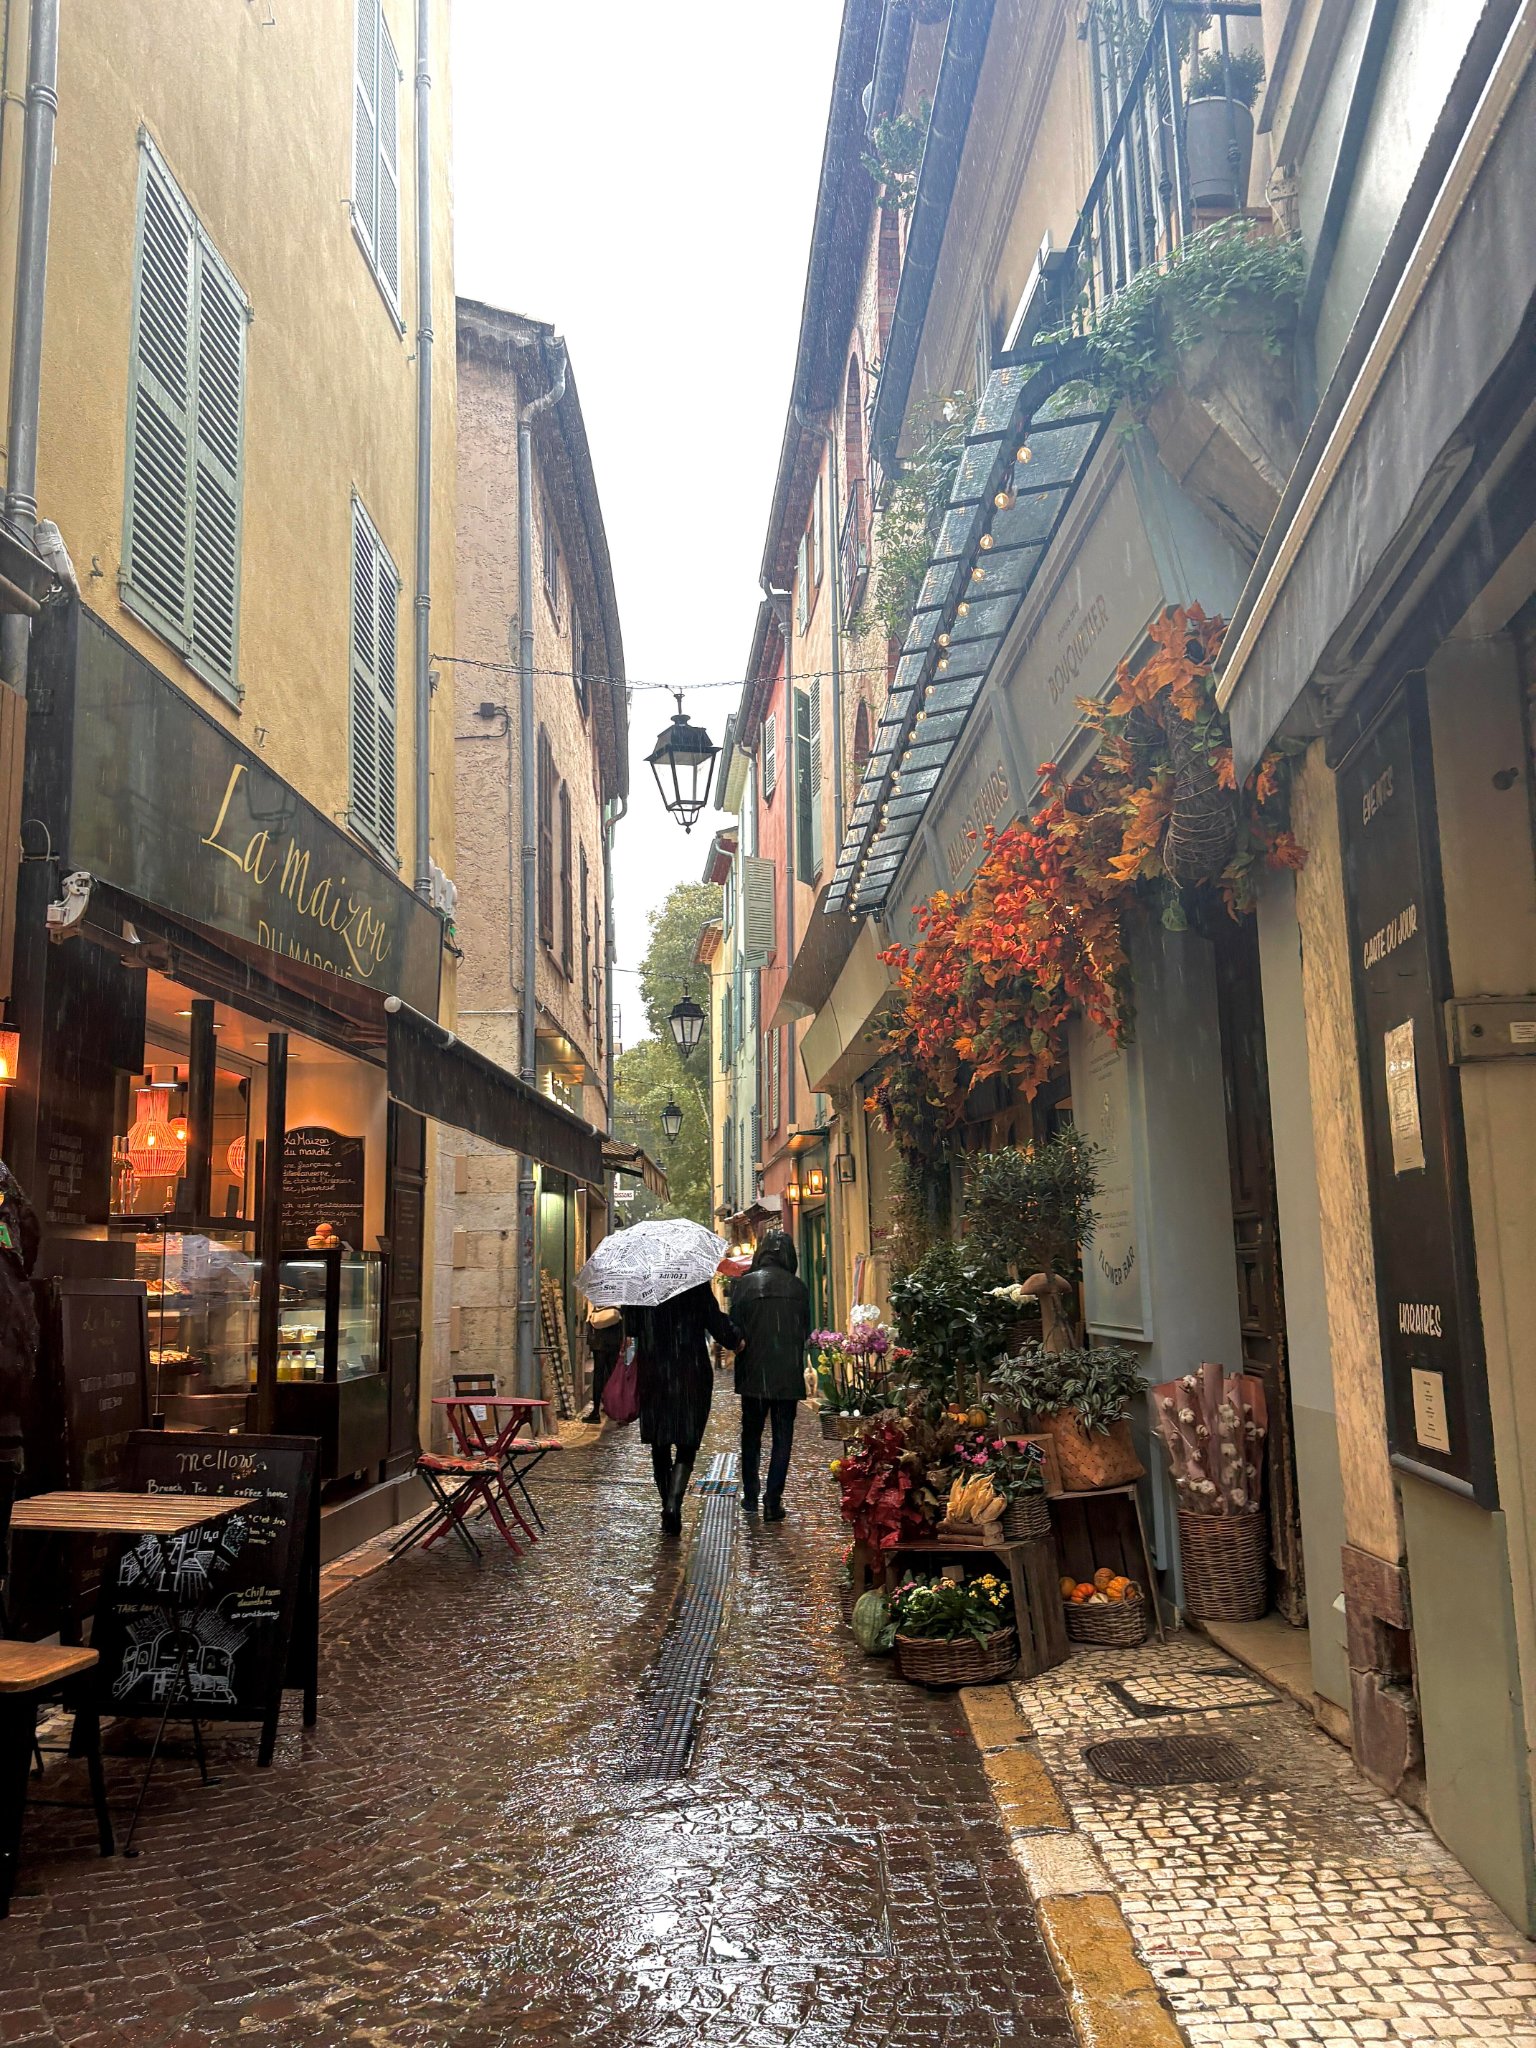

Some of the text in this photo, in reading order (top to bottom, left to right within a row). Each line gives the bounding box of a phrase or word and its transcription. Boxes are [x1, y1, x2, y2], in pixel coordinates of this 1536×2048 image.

[1048, 594, 1109, 705] BOUQUETIER
[201, 763, 392, 978] La Maizon
[1363, 903, 1418, 970] CARTE DU JOUR
[1098, 1245, 1135, 1286] FLOWER BAR
[1399, 1302, 1443, 1338] HORAIRES
[234, 1487, 263, 1498] coffee
[245, 1586, 266, 1598] Chill
